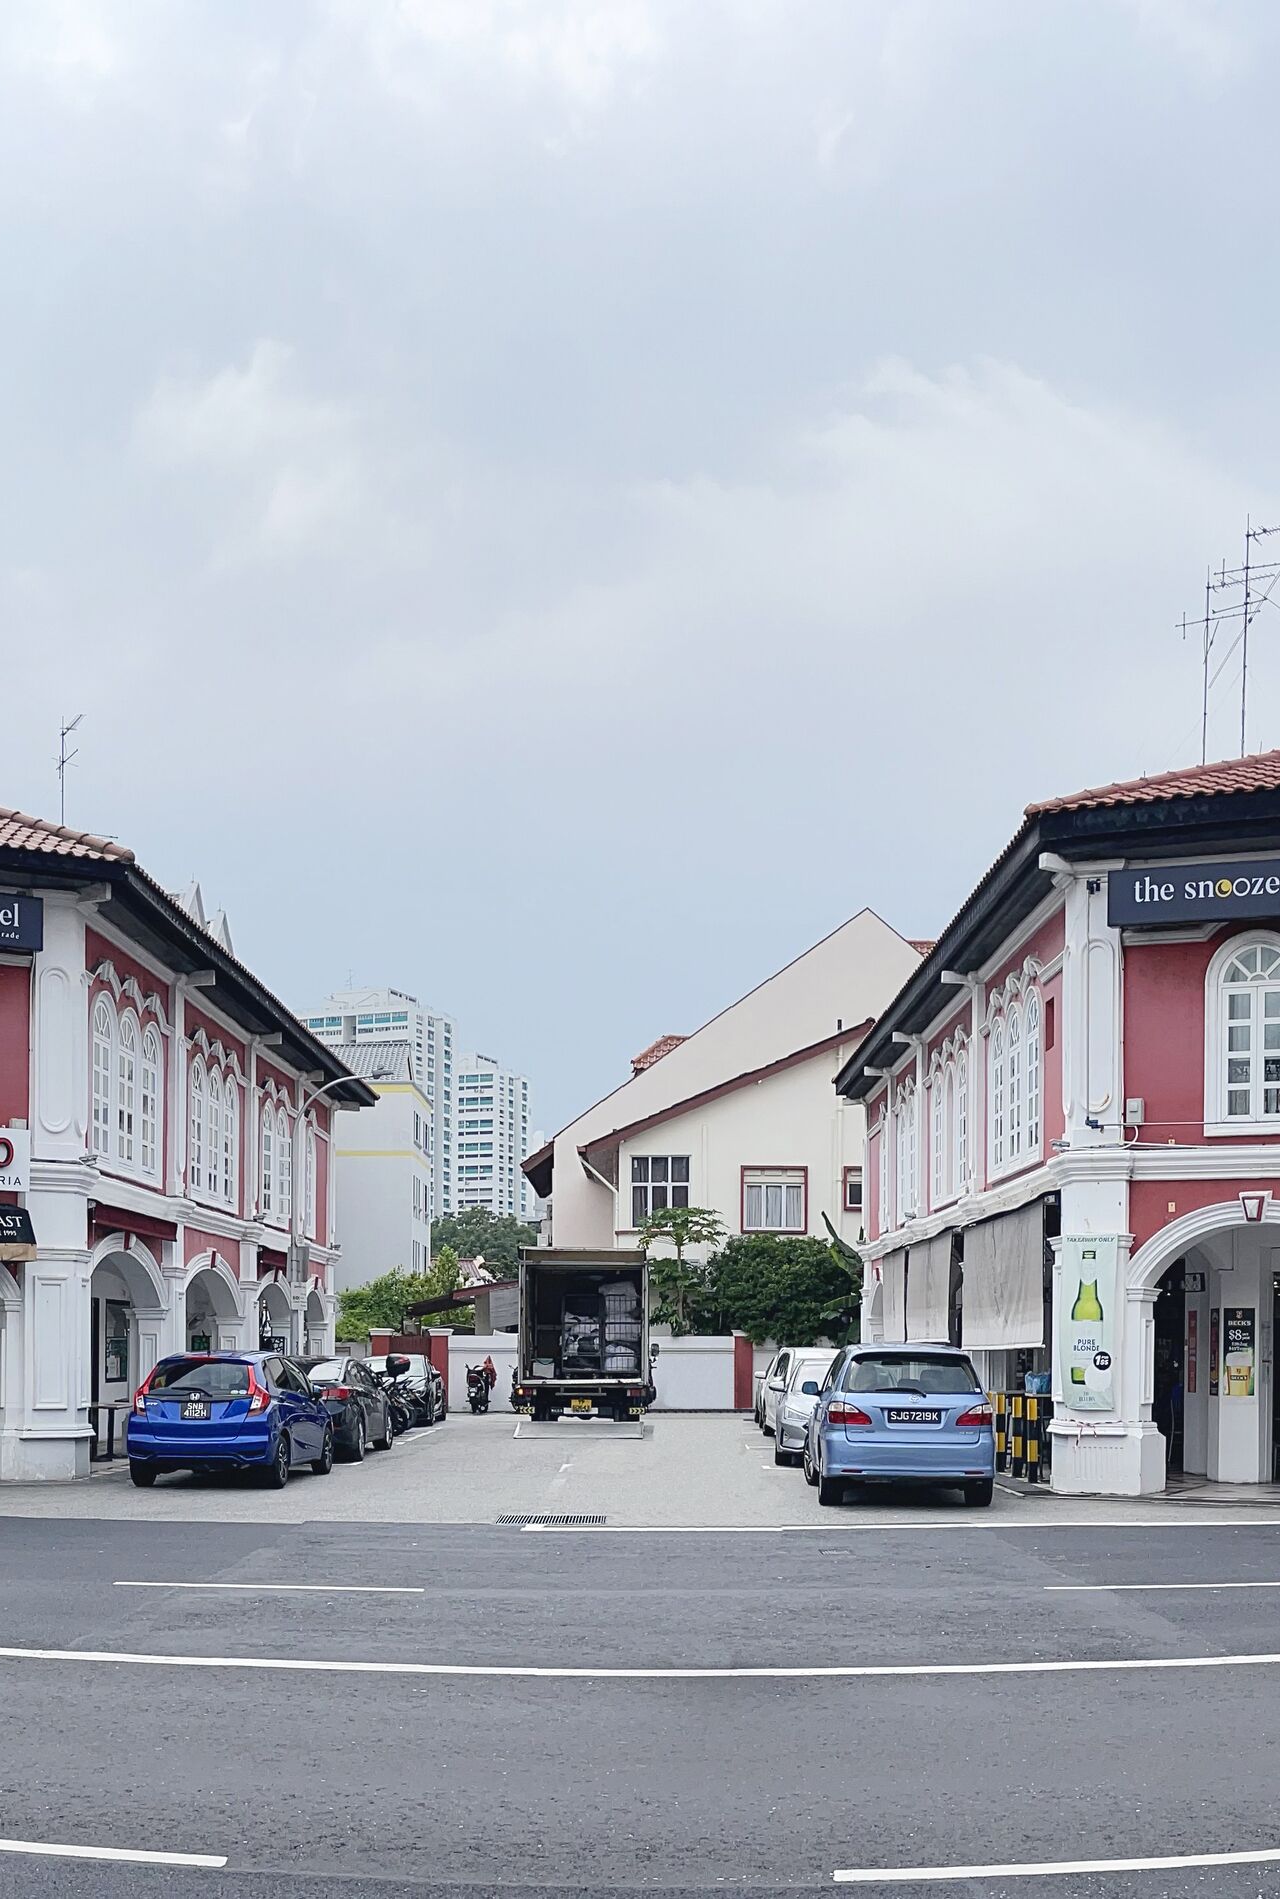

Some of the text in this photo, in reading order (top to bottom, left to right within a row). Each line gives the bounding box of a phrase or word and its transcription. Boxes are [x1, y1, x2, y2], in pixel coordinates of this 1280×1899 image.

[1134, 877, 1175, 902] the
[1184, 876, 1280, 899] snooze
[1228, 1329, 1242, 1340] $8
[1077, 1338, 1096, 1346] PURE
[1073, 1344, 1100, 1352] BLONDE
[187, 1402, 204, 1410] SNB
[183, 1409, 207, 1417] 4112H
[890, 1411, 939, 1421] SJG7219K
